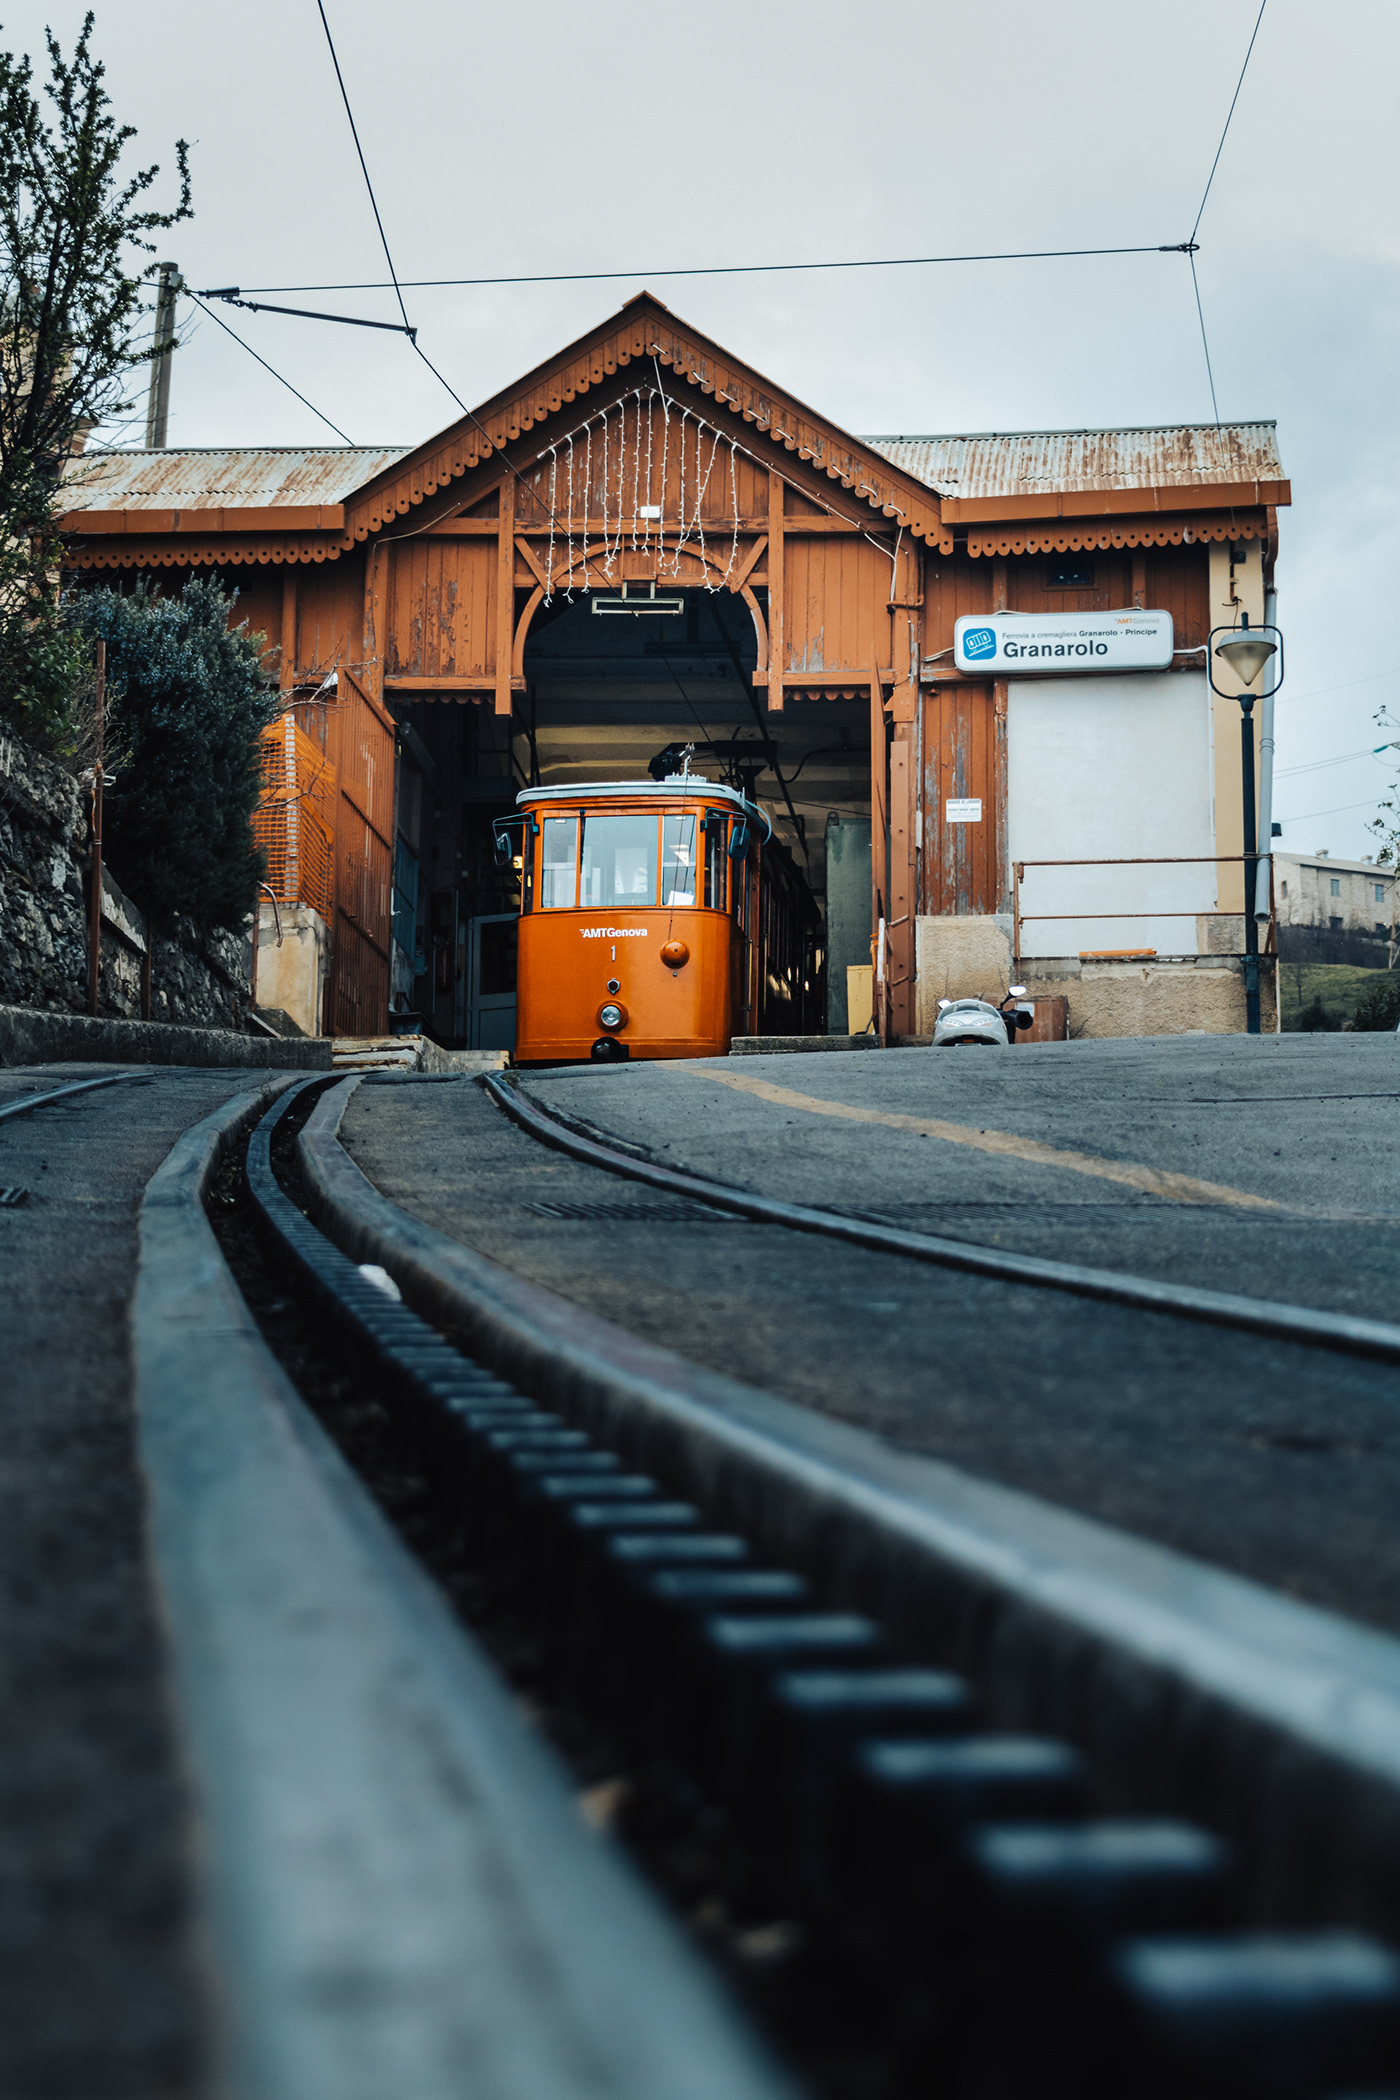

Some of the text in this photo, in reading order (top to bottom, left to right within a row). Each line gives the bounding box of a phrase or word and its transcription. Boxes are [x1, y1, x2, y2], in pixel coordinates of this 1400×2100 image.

[1002, 632, 1030, 640] Ferrovia
[1037, 631, 1077, 640] cremagliera
[1125, 628, 1158, 636] Principe
[1003, 640, 1108, 658] Granarolo
[611, 945, 616, 962] 1
